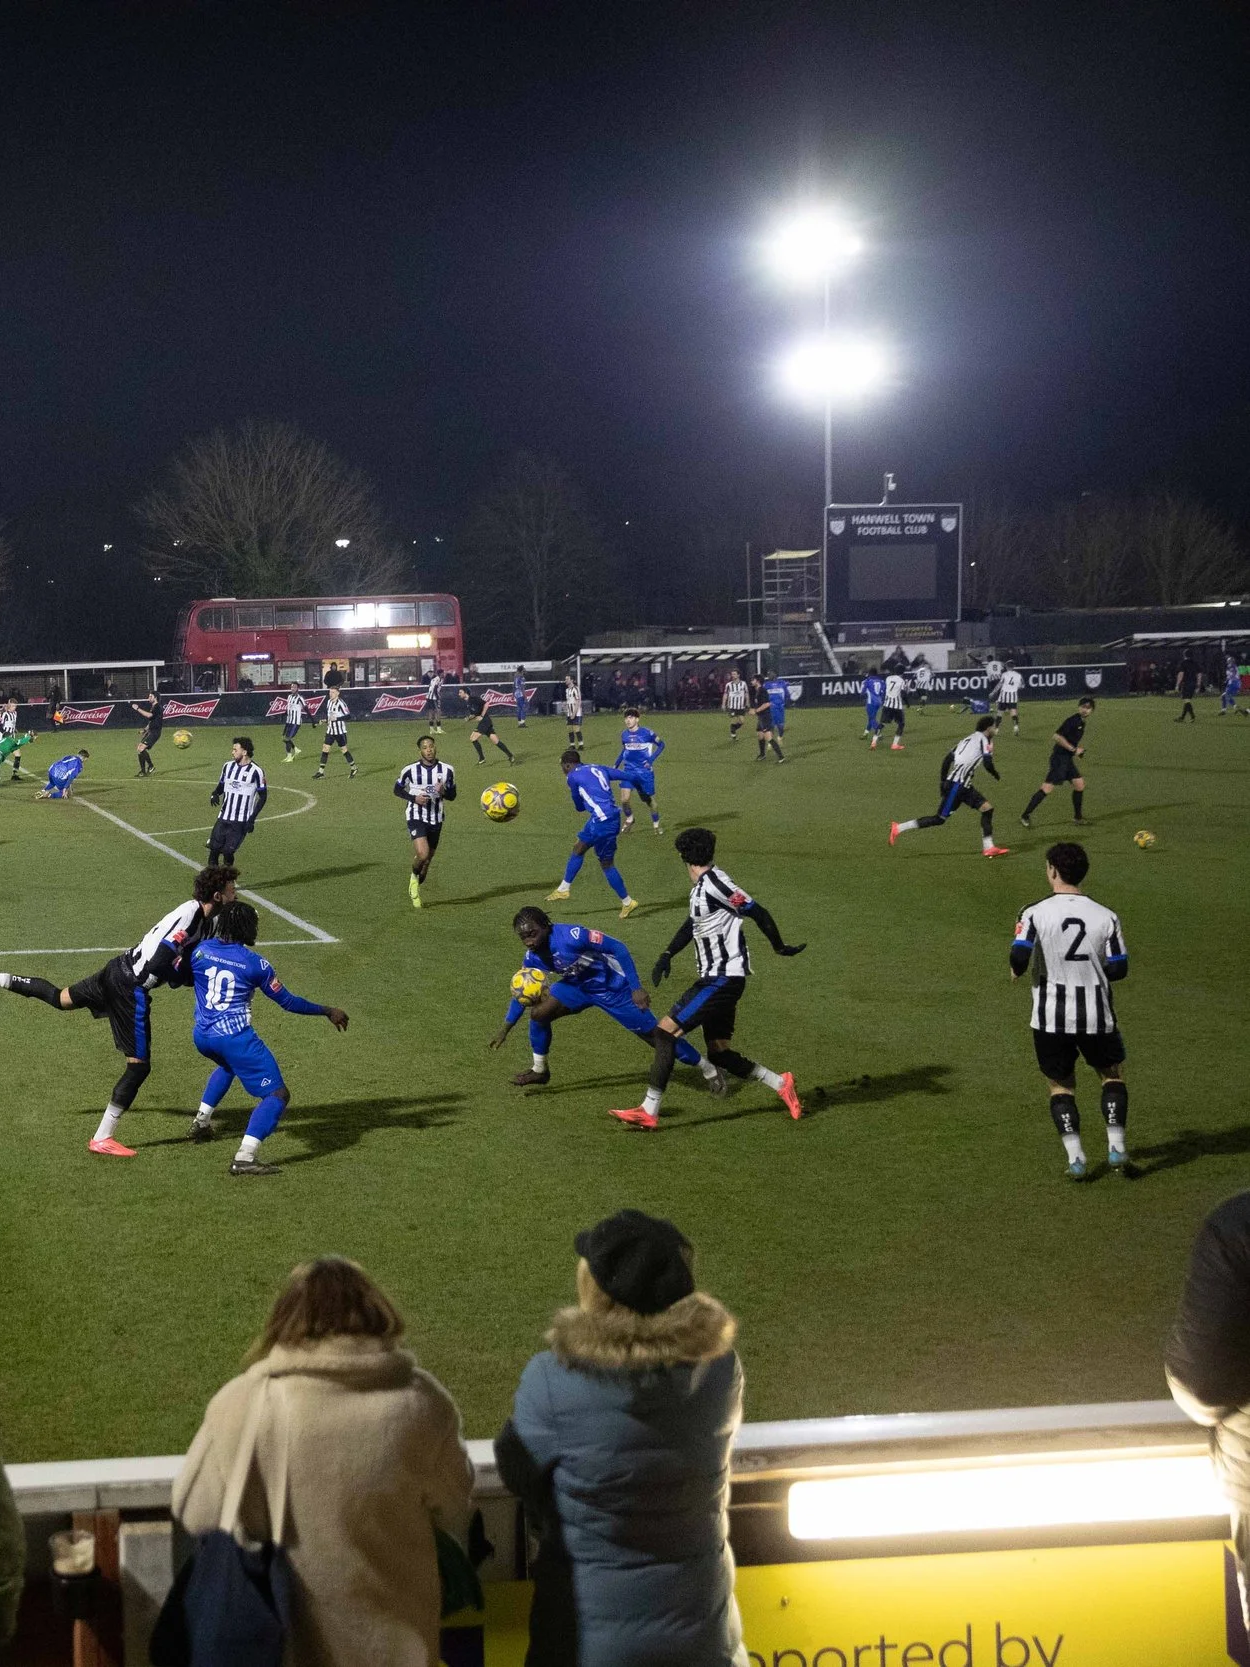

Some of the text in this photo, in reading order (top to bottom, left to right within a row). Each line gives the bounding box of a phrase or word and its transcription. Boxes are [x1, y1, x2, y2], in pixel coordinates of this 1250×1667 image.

[851, 513, 936, 525] HANWELL TOWN
[857, 525, 928, 536] FOOTBALL CLUB
[890, 680, 896, 692] 7
[1008, 677, 1015, 686] 4
[1028, 673, 1067, 687] CLUB
[376, 695, 427, 708] Budweiser
[62, 709, 109, 721] Budweiser
[162, 703, 215, 716] Budweiser
[959, 738, 972, 755] 7
[590, 767, 610, 791] 8
[1061, 917, 1090, 961] 2
[204, 966, 236, 1011] 10
[1107, 1102, 1117, 1124] HTFC
